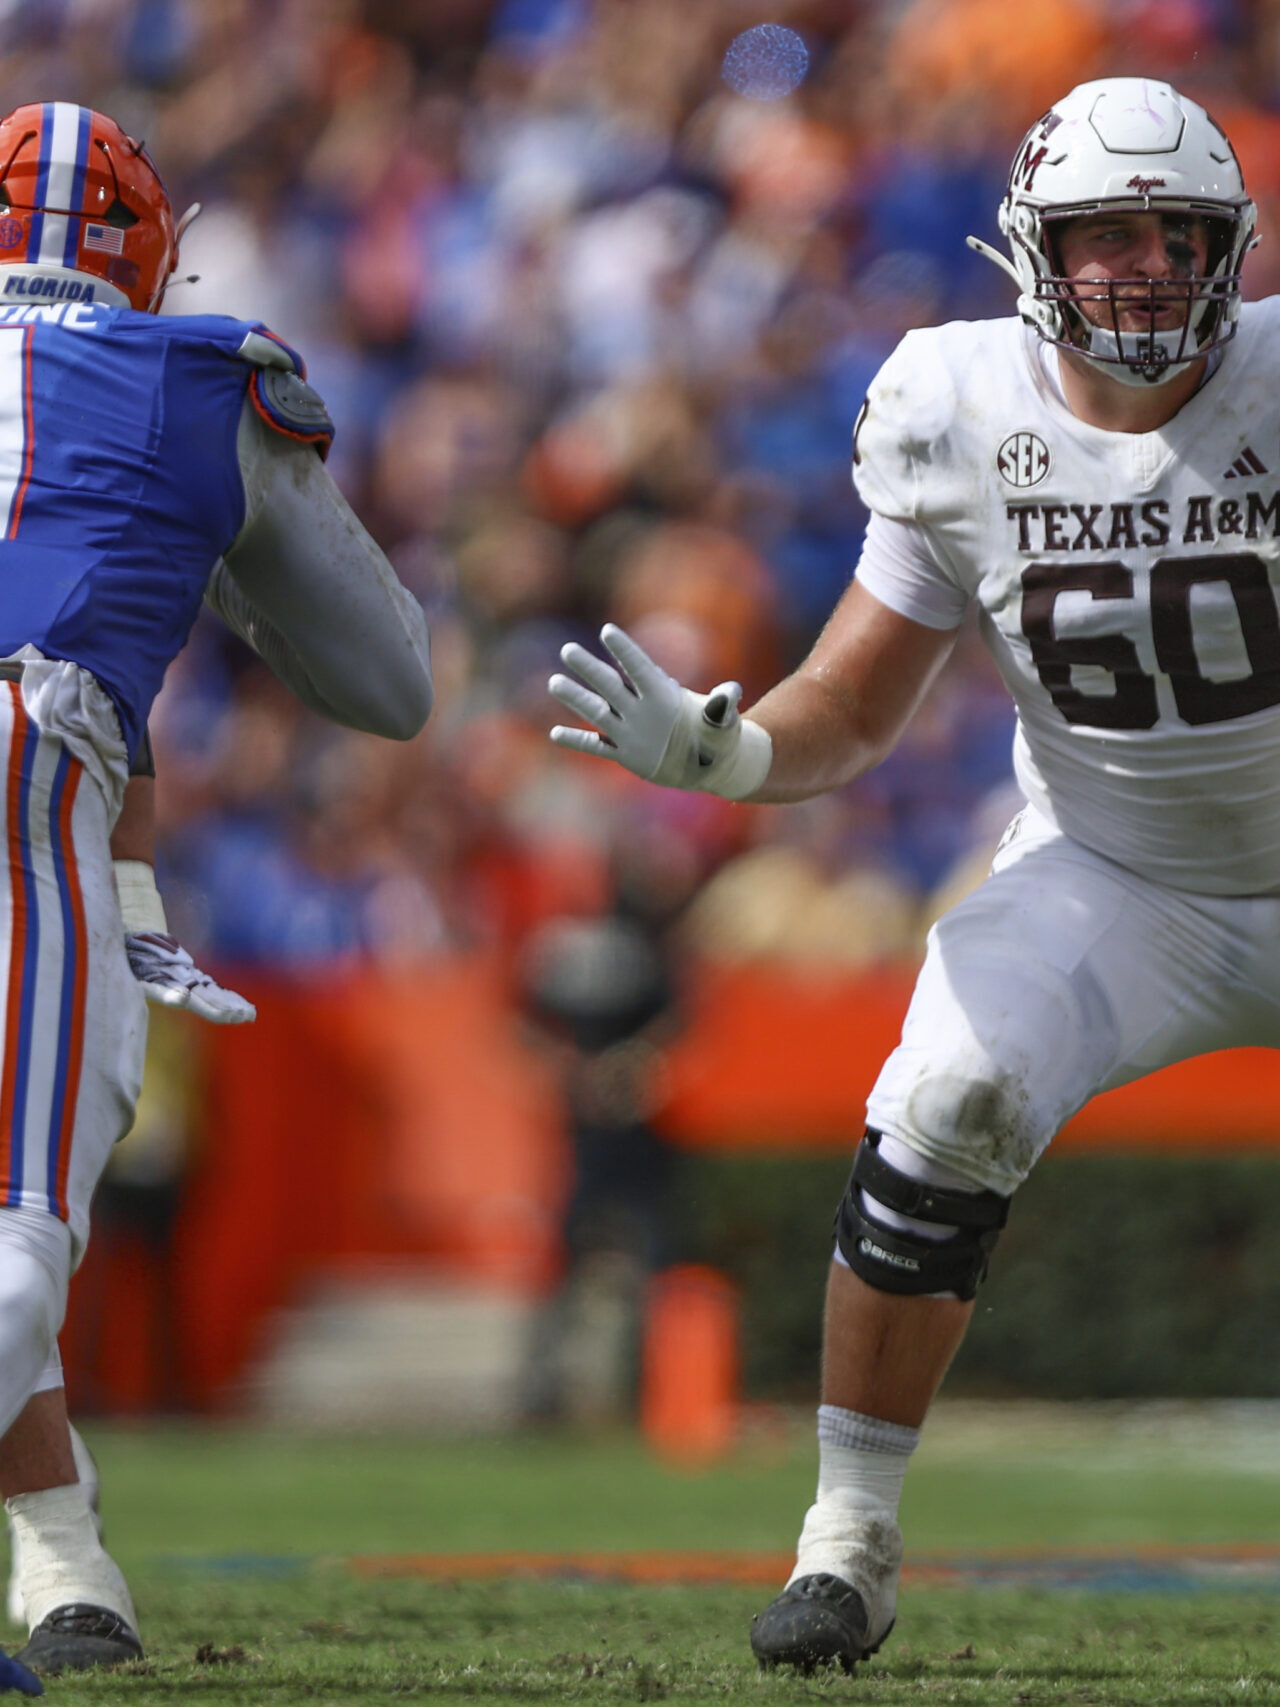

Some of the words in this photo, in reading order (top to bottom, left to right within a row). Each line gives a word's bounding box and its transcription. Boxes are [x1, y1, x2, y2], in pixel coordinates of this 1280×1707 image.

[1126, 174, 1167, 194] Aggies
[3, 273, 97, 302] FLORIDA
[997, 431, 1051, 488] SEC
[1006, 499, 1171, 551] TEXAS
